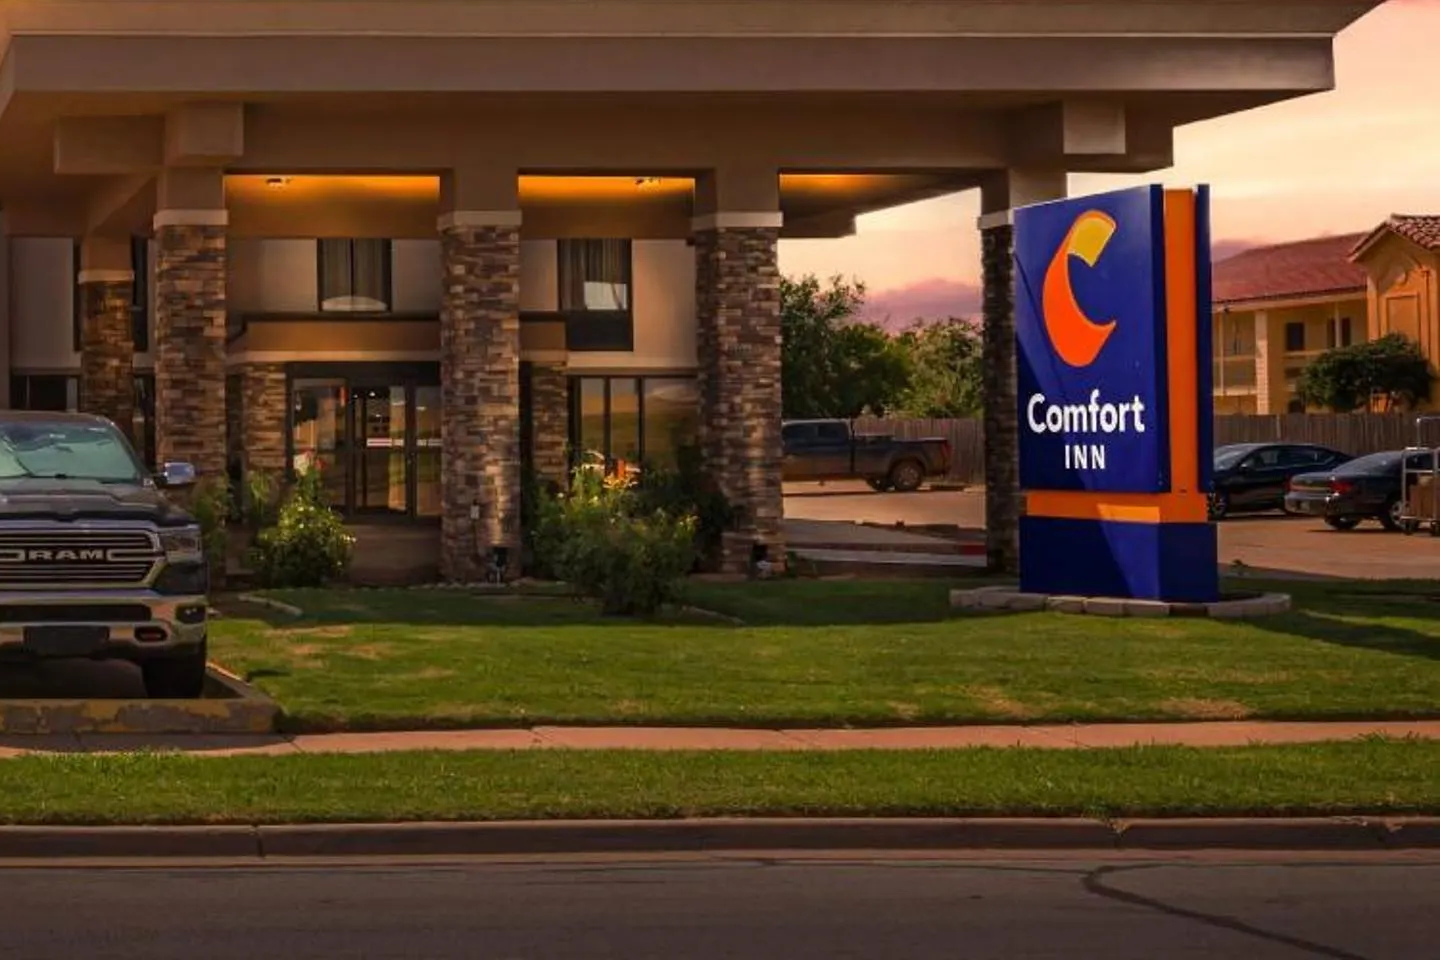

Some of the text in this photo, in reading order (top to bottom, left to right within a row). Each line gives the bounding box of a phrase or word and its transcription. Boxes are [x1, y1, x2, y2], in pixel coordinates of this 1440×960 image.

[1027, 389, 1145, 433] Comfort
[1064, 444, 1105, 469] INN
[28, 550, 104, 560] RAM
